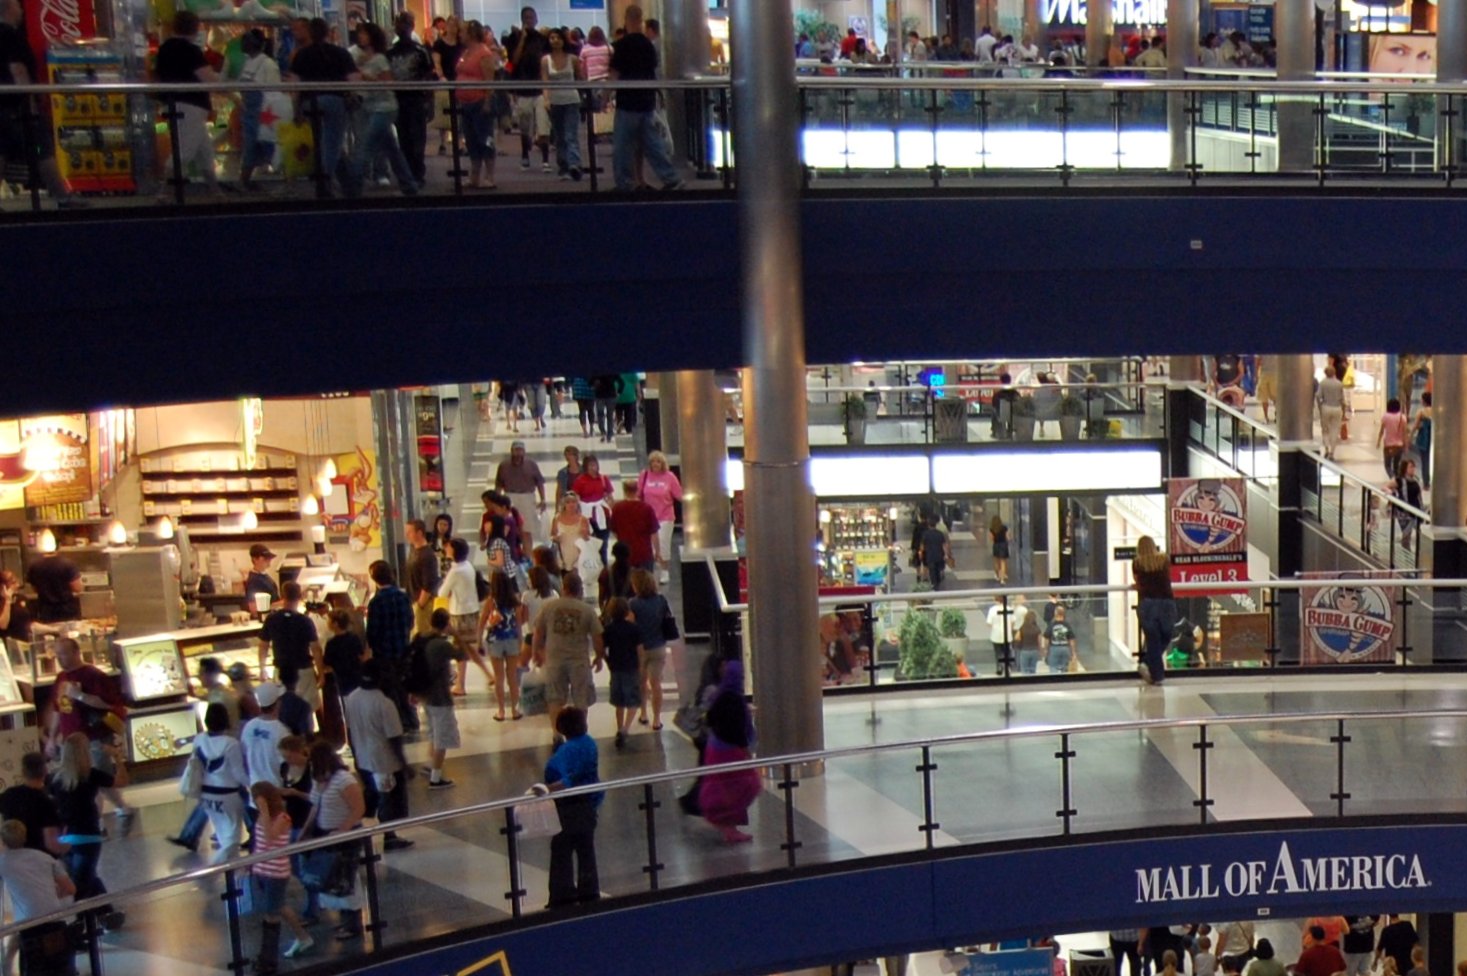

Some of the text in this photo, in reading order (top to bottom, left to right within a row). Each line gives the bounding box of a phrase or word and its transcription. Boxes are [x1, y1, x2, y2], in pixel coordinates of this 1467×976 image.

[1173, 509, 1244, 535] BUBBA GUMP
[1306, 609, 1391, 641] BUBBA GUMP
[1135, 840, 1428, 903] MALL OF AMERICA
